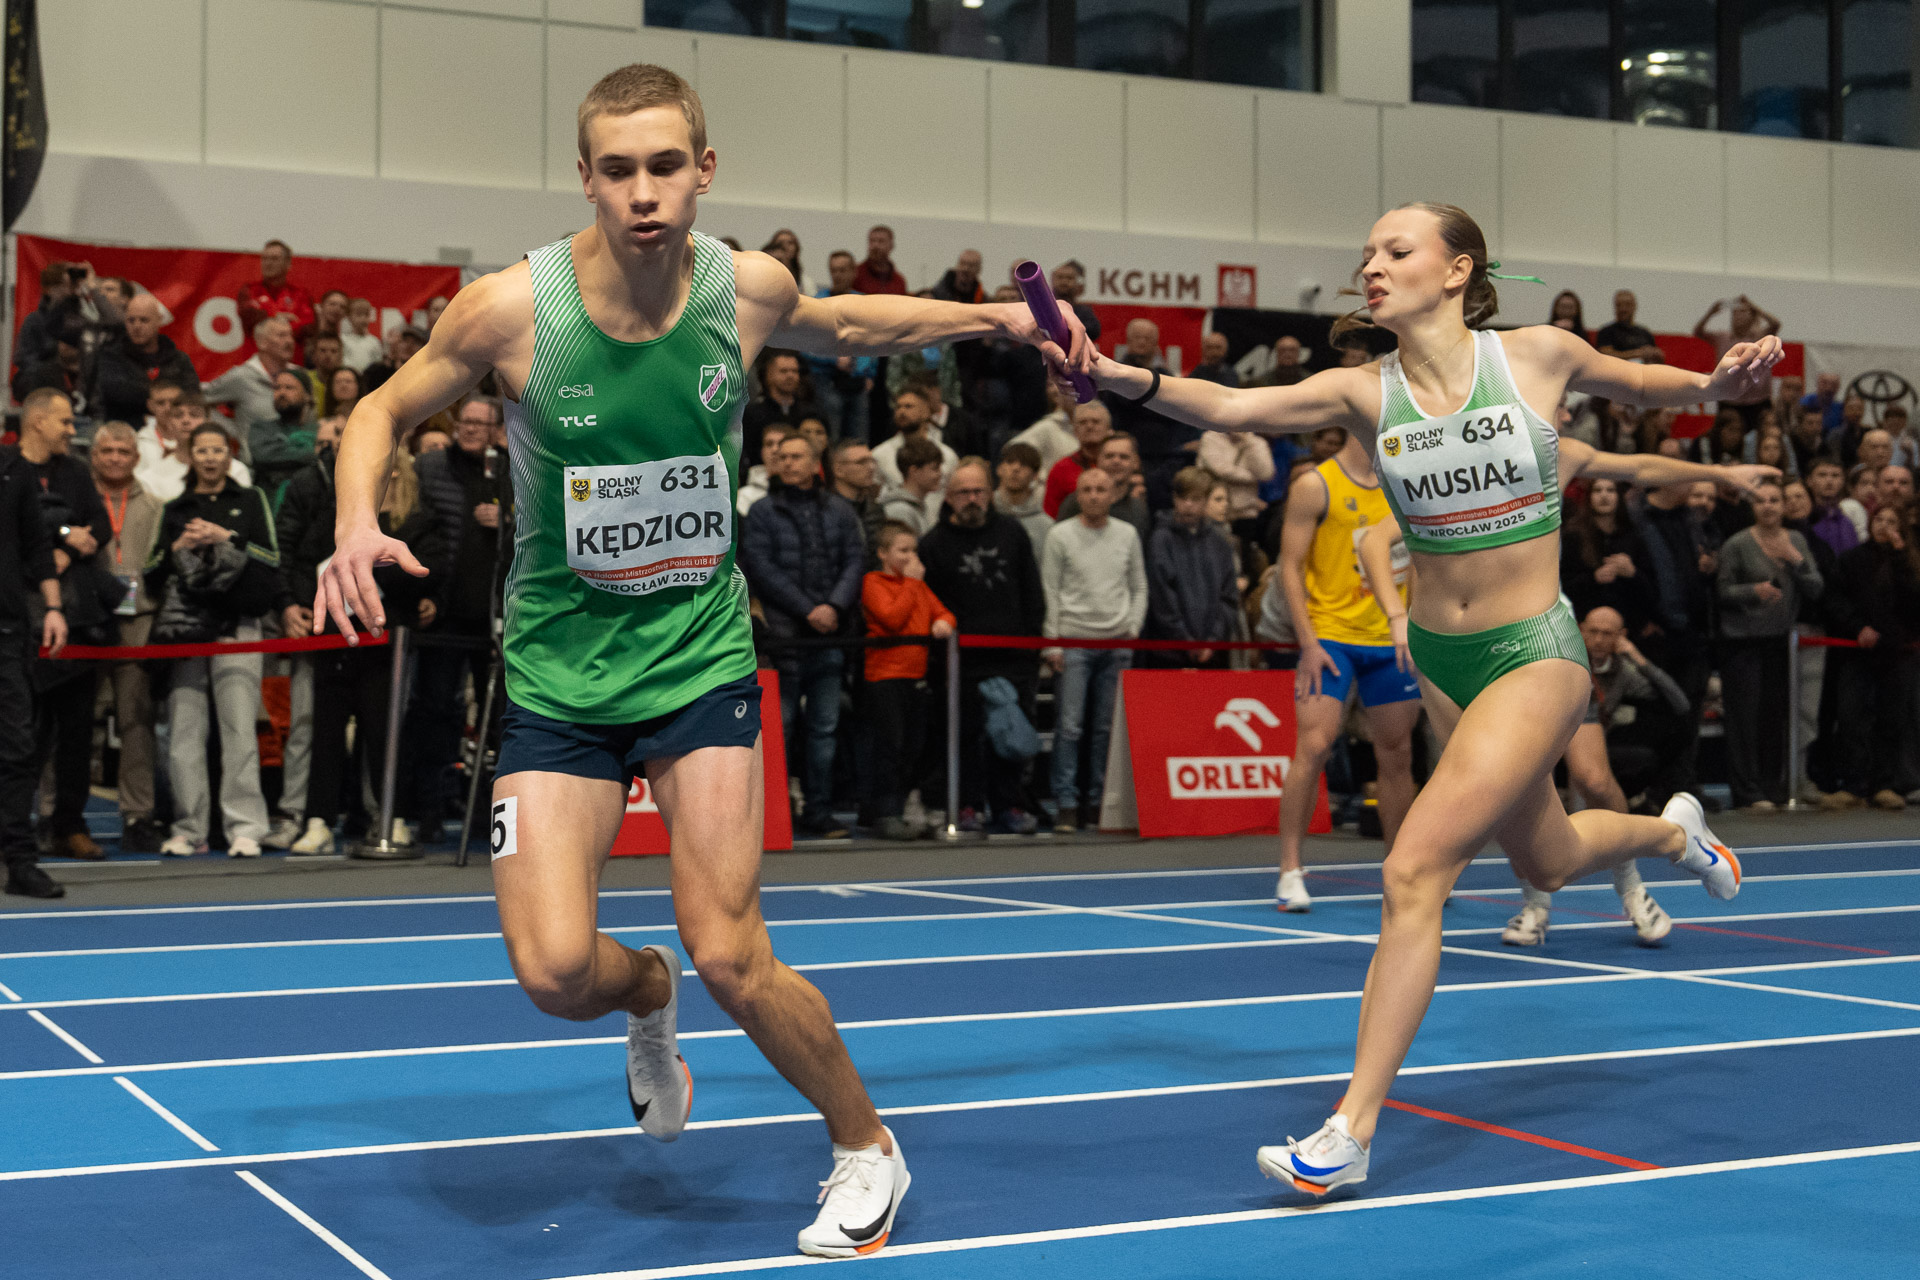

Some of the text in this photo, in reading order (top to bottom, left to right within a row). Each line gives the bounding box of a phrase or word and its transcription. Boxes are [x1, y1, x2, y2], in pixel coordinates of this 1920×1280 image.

[1099, 268, 1200, 300] KGHM
[558, 383, 594, 399] esa
[558, 414, 597, 428] TLC
[1461, 412, 1515, 444] 634
[1405, 427, 1444, 443] DOLNY
[597, 475, 643, 489] DOLNY
[660, 464, 719, 492] 631
[1402, 459, 1524, 502] MUSIAŁ
[1488, 504, 1510, 516] Polski
[576, 510, 726, 559] KĘDZIOR
[1427, 512, 1527, 538] WROCŁAW 2025
[625, 562, 669, 578] Mistrzostwa
[669, 559, 693, 568] Polski
[694, 558, 708, 566] U18
[595, 571, 708, 593] WROCŁAW 2025
[1177, 764, 1283, 791] ORLEN
[491, 802, 507, 855] 5
